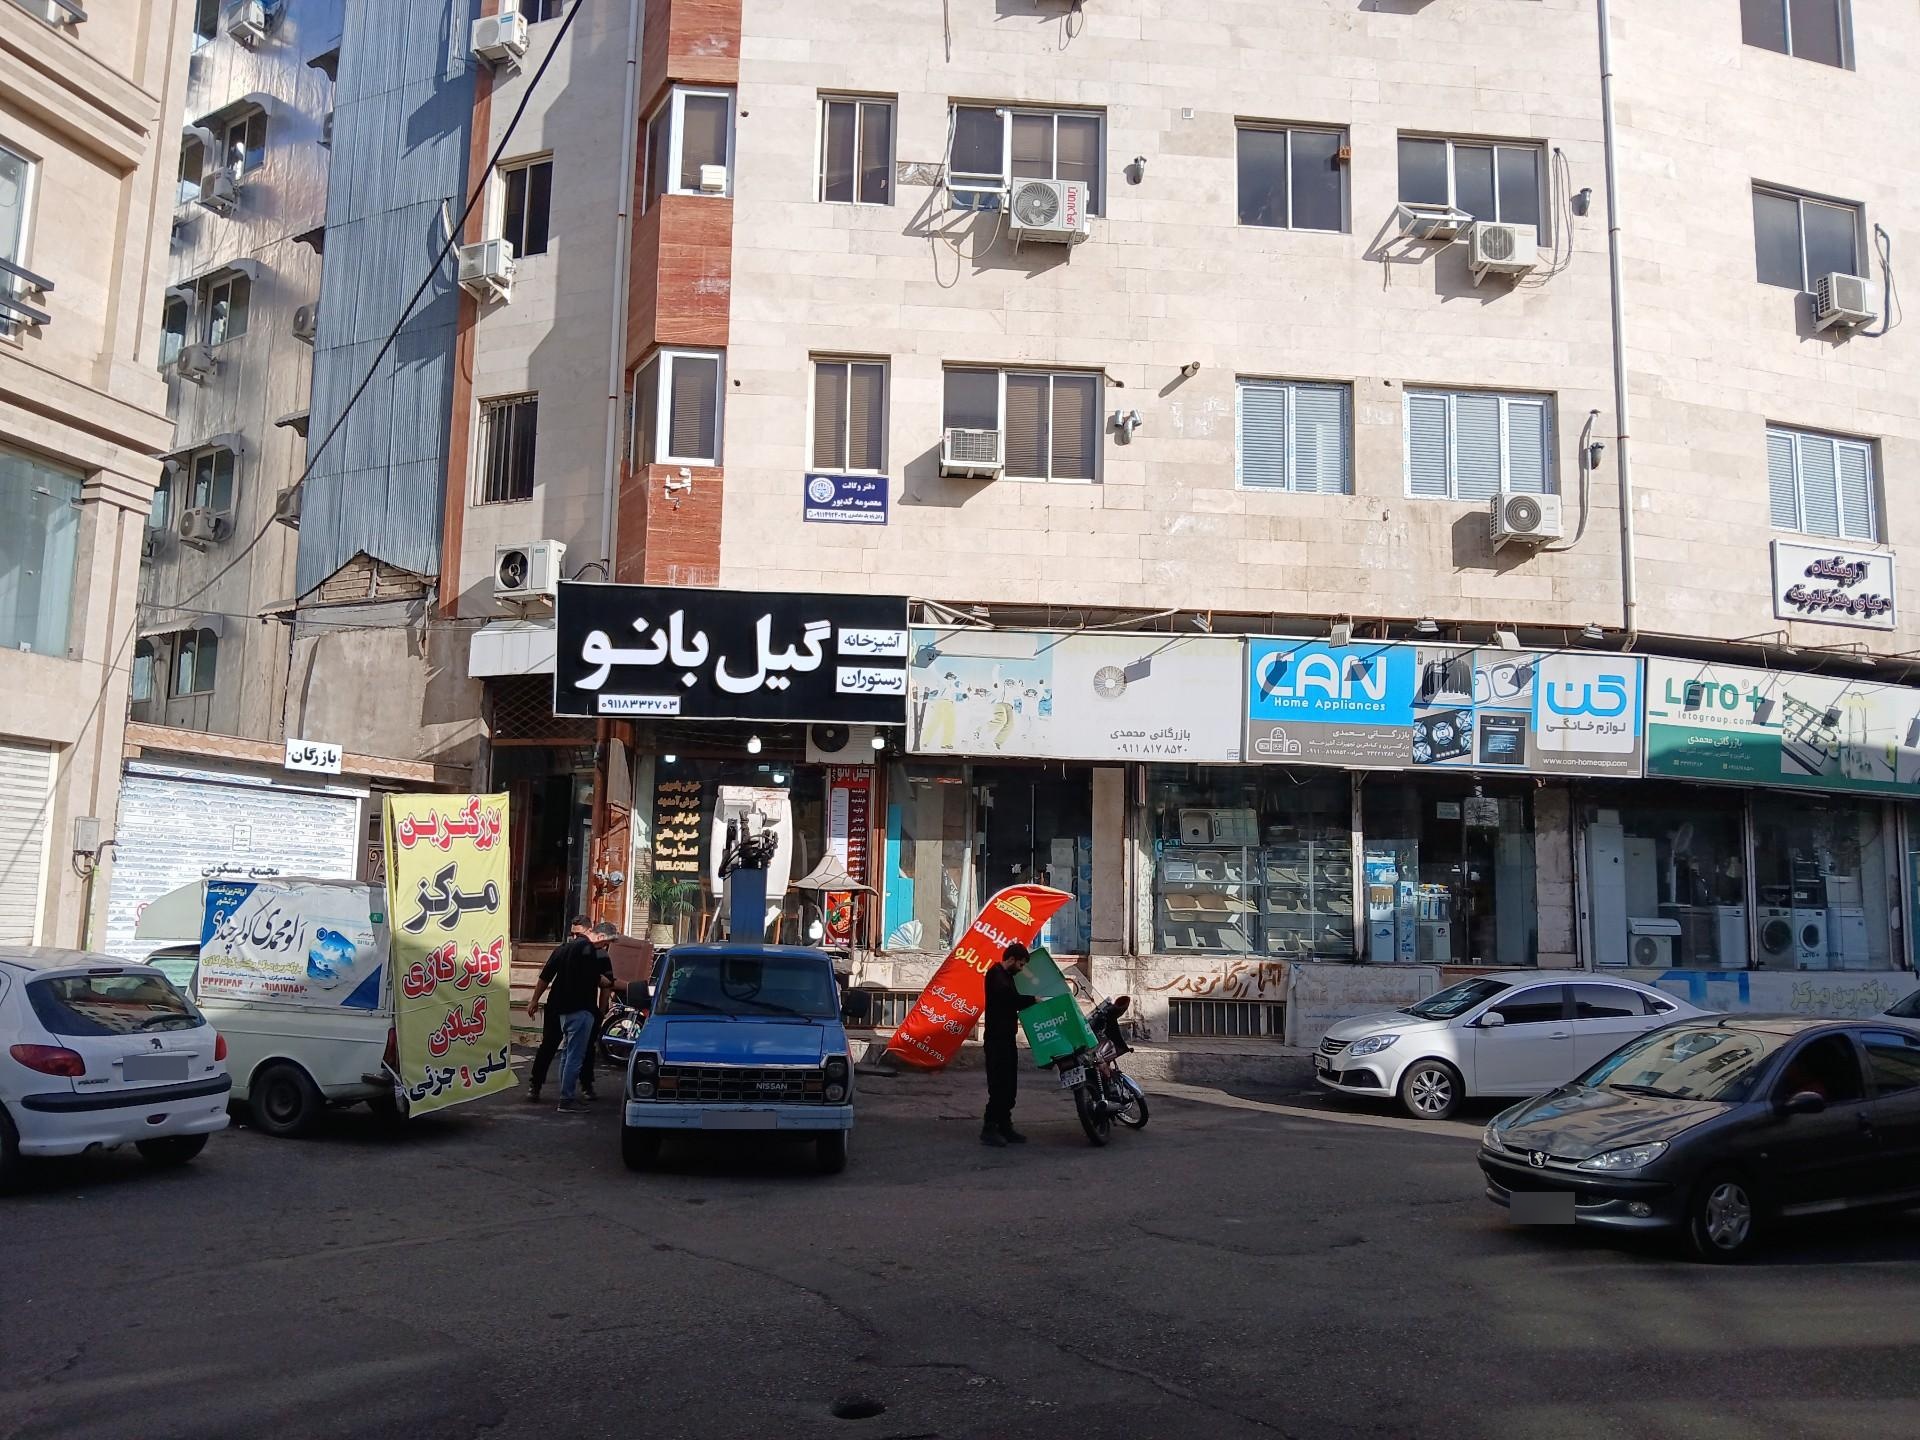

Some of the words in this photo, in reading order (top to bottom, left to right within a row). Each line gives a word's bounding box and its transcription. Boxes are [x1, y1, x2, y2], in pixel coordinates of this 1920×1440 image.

[574, 609, 709, 690] بانو
[844, 632, 902, 653] آشپزخانه
[715, 613, 831, 693] گیل
[841, 669, 902, 691] رستوران
[1256, 652, 1387, 700] CAN
[1665, 677, 1739, 710] LETO
[601, 697, 677, 711] ۰۹۱۱۸۳۳۲۷۰۳
[1274, 697, 1309, 708] Home
[1315, 699, 1386, 711] Appliances
[1546, 718, 1594, 732] خانگی
[1596, 721, 1626, 734] لوازم
[1678, 710, 1753, 726] letogroup.com
[1110, 730, 1146, 740] محمدی
[1150, 727, 1191, 741] بازرگانی
[1332, 730, 1366, 739] محمدی
[1367, 729, 1410, 740] بازرگانی
[1687, 735, 1713, 745] محمدی
[291, 747, 337, 767] بازرگان
[398, 795, 502, 851] بزرگترین
[201, 862, 243, 877] مسکونی
[247, 866, 280, 879] مجتمع
[656, 861, 699, 872] WELCOME
[402, 861, 500, 934] مرکز
[974, 920, 1024, 949] شپزخانه
[454, 935, 504, 991] کولر
[955, 947, 981, 965] بانو
[403, 940, 457, 999] گازی
[932, 985, 956, 1001] کباب
[920, 1003, 945, 1023] خورشت
[952, 998, 978, 1016] انواع
[428, 995, 488, 1057] گیلان
[944, 1019, 965, 1035] انواع
[1033, 1011, 1068, 1032] Snapp!
[1037, 1029, 1059, 1042] Box
[473, 1045, 508, 1083] کلی
[410, 1065, 456, 1101] جزئی
[459, 1065, 472, 1088] و
